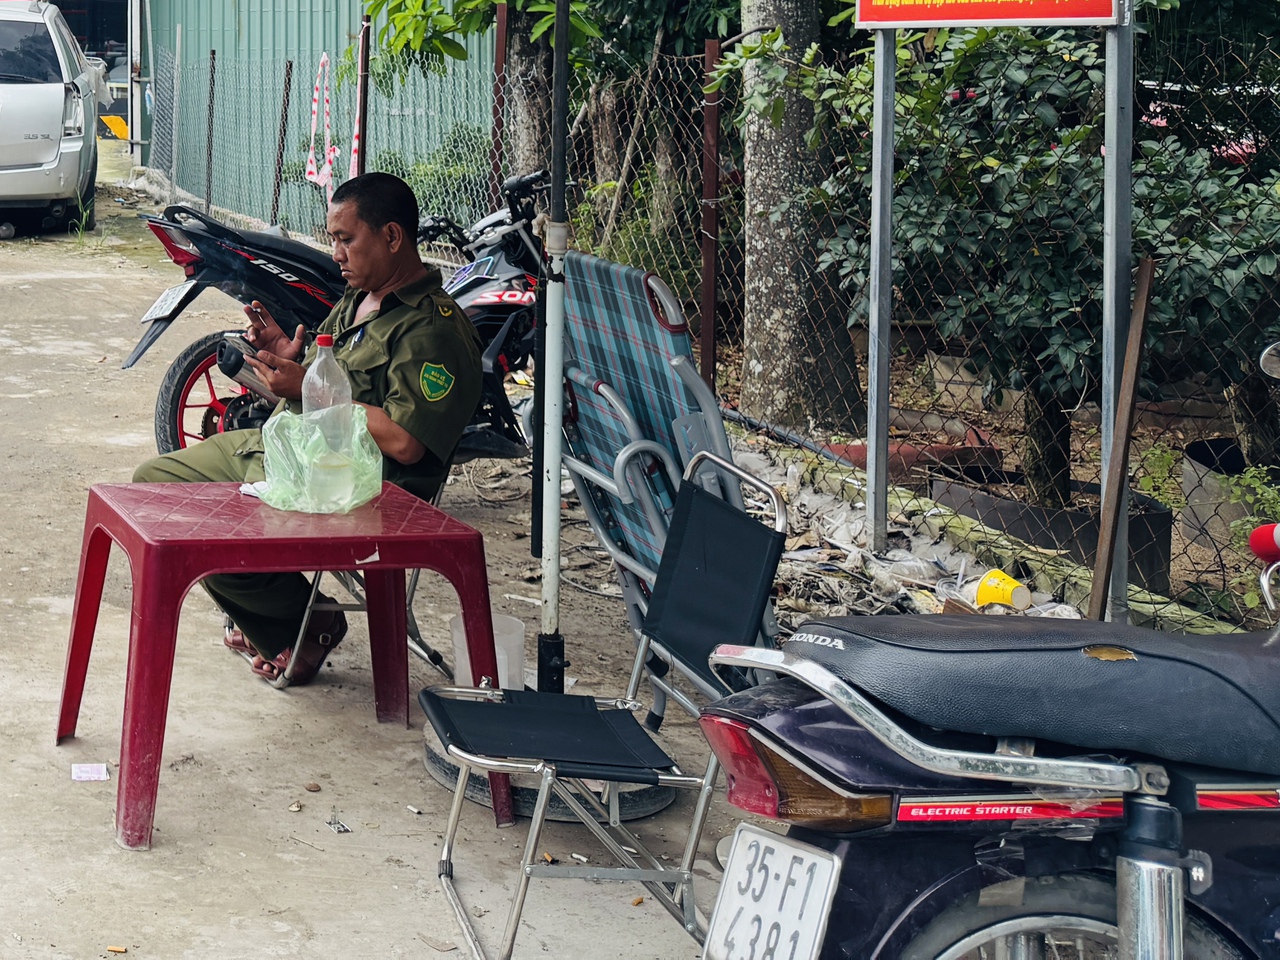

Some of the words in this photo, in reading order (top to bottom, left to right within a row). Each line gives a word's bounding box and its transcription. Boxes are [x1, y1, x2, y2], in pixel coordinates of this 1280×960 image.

[788, 633, 845, 650] HONDA
[910, 807, 971, 816] ELECTRIC
[975, 806, 1033, 815] STARTER
